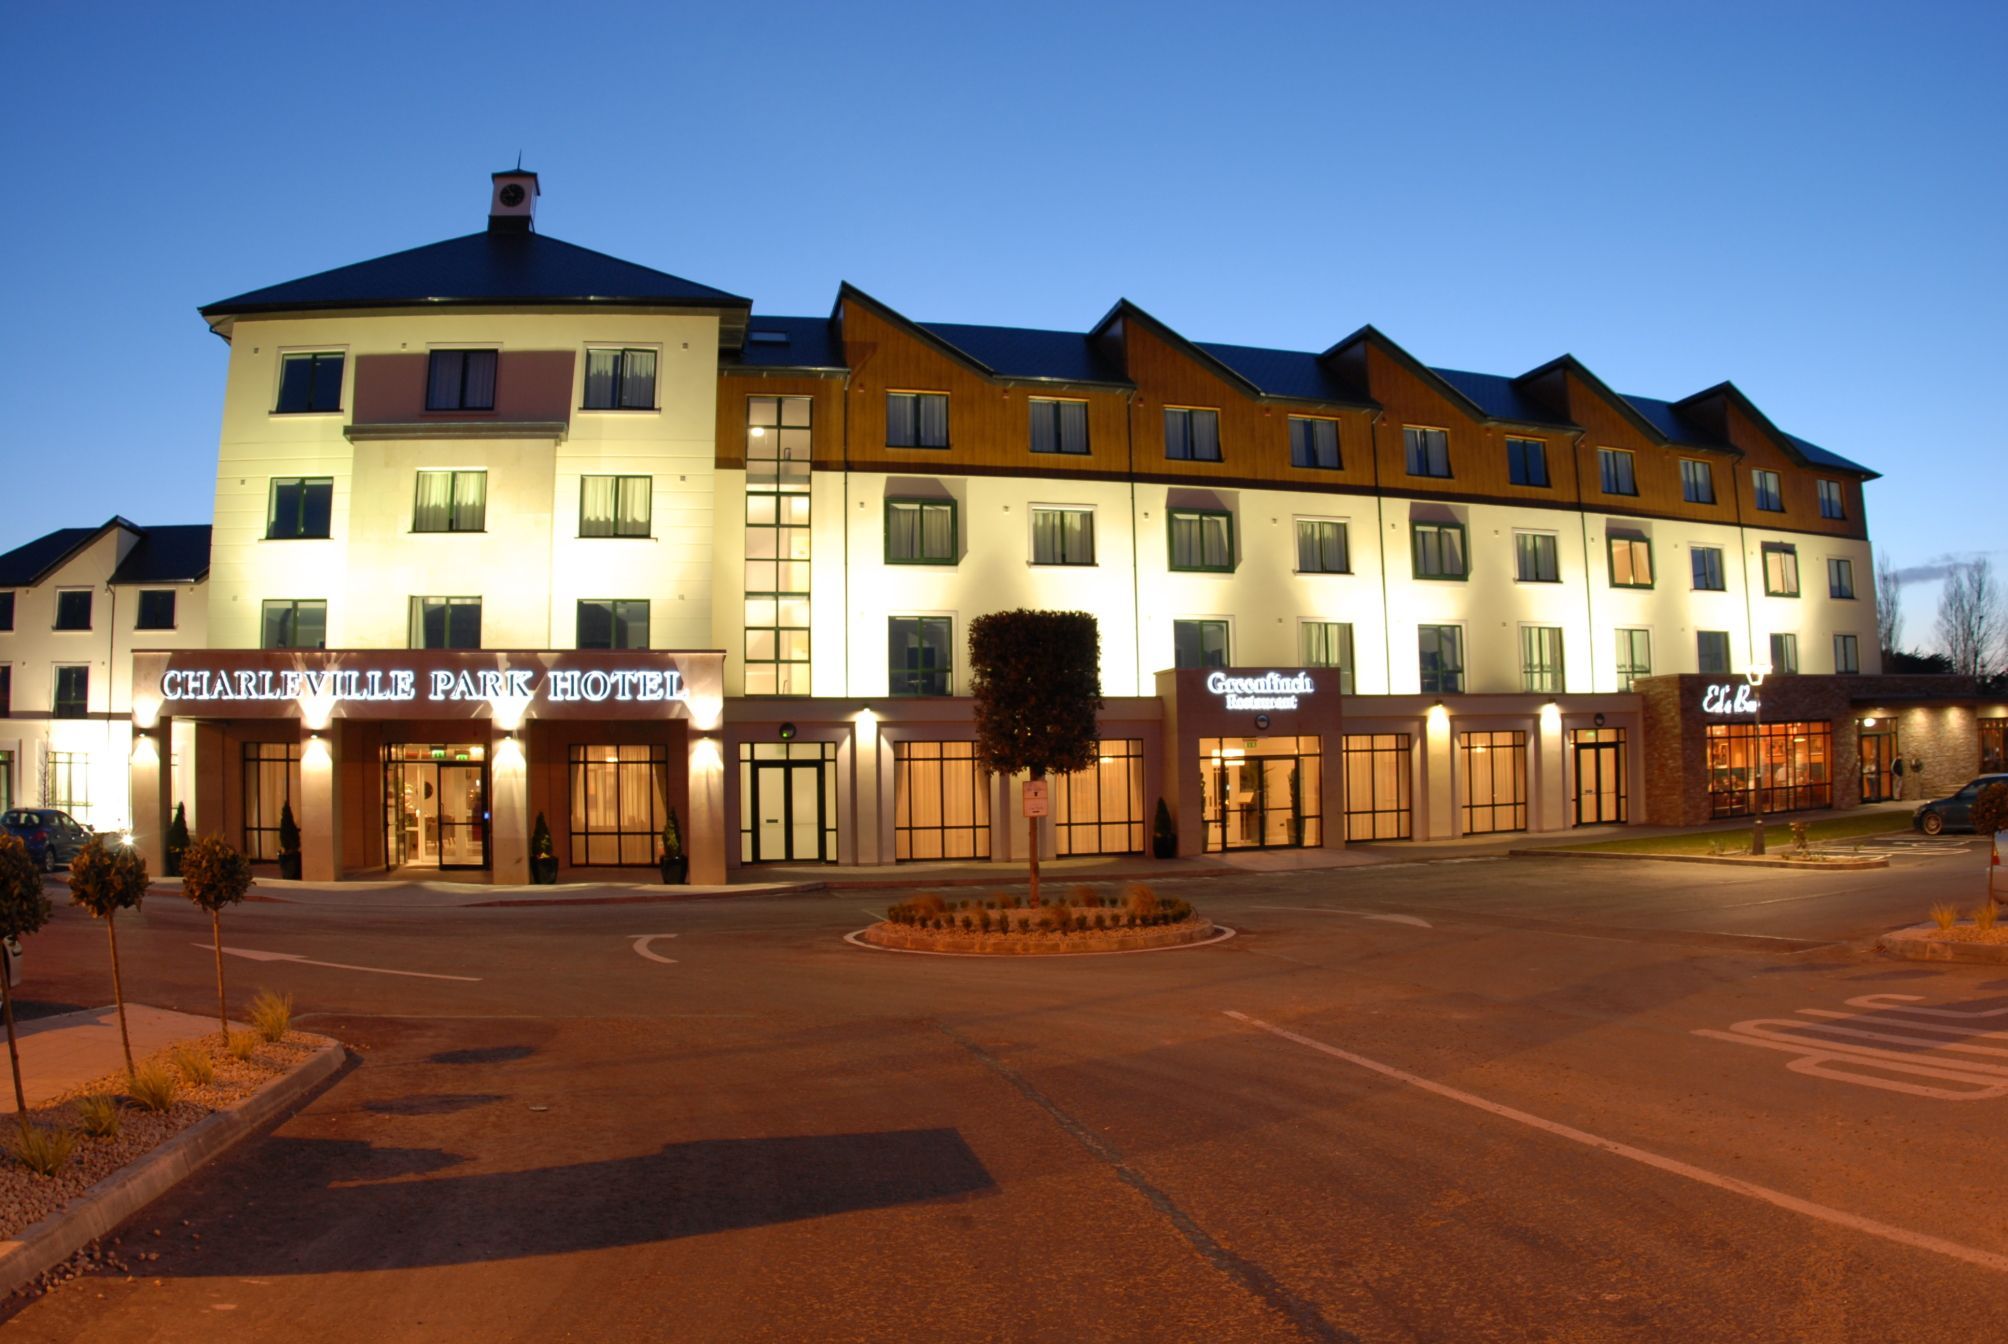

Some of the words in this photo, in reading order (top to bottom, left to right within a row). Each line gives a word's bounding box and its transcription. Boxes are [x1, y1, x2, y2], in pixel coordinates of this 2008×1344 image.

[160, 670, 415, 700] CHARLEVILLE
[428, 670, 533, 700] PARK
[547, 670, 690, 700] HOTEL
[1207, 671, 1315, 694] Greenfinch
